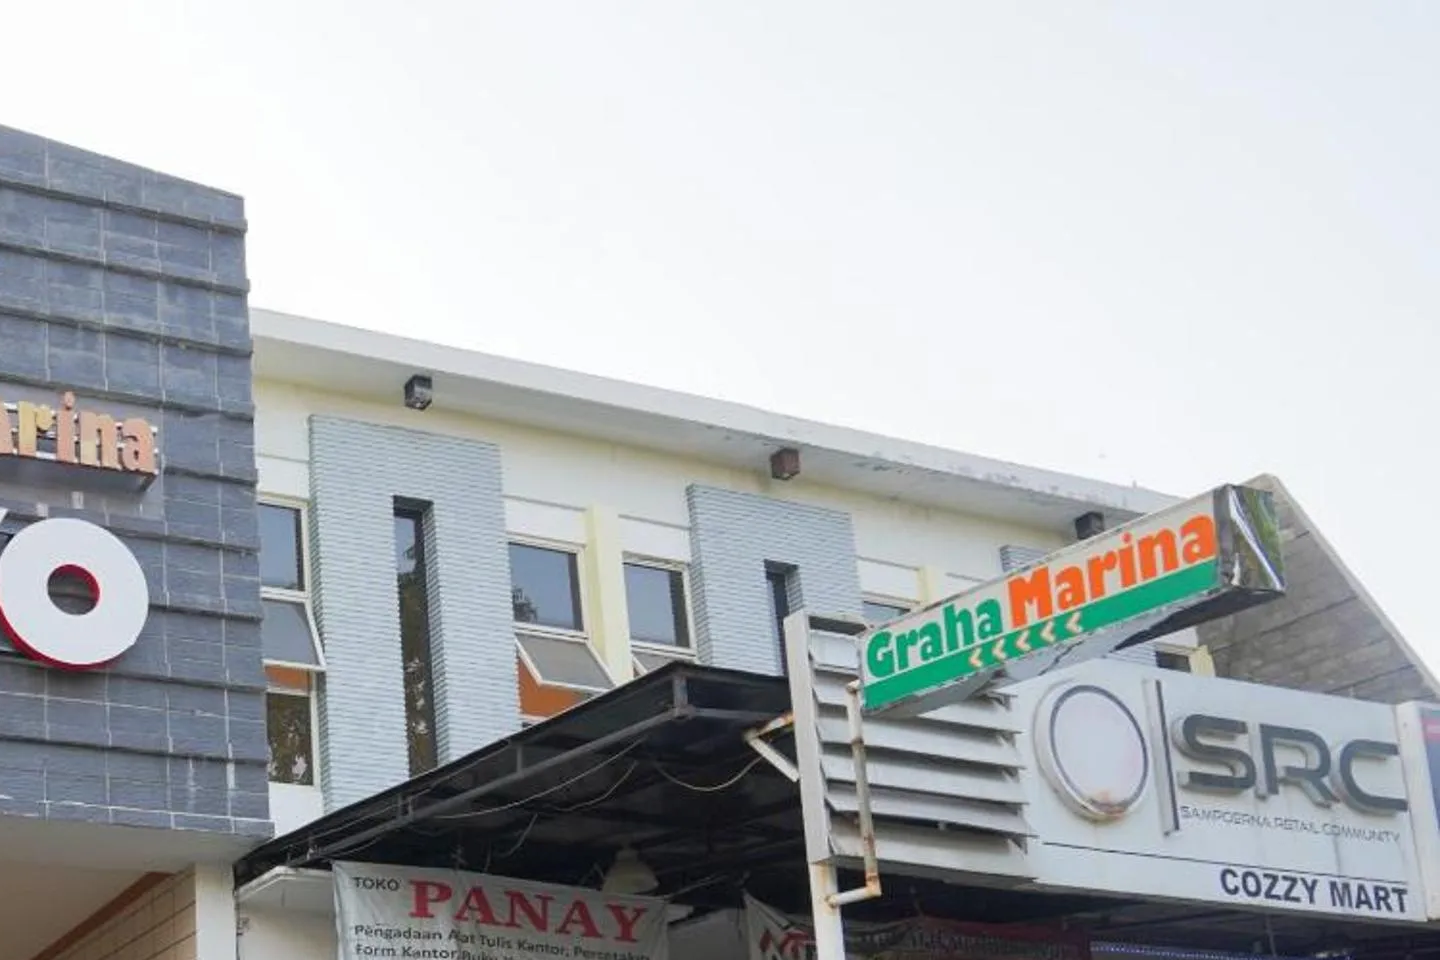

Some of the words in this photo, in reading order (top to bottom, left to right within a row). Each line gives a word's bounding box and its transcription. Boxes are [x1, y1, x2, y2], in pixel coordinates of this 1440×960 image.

[866, 598, 1003, 678] Graha
[1008, 514, 1217, 628] Marina
[1174, 713, 1409, 815] SRC
[352, 876, 399, 892] TOKO
[408, 879, 649, 943] PANAY
[1220, 867, 1318, 905] COZZY
[1329, 880, 1408, 914] MART
[354, 924, 443, 941] Pengadaan
[479, 934, 513, 950] Tulis
[356, 944, 397, 956] Form
